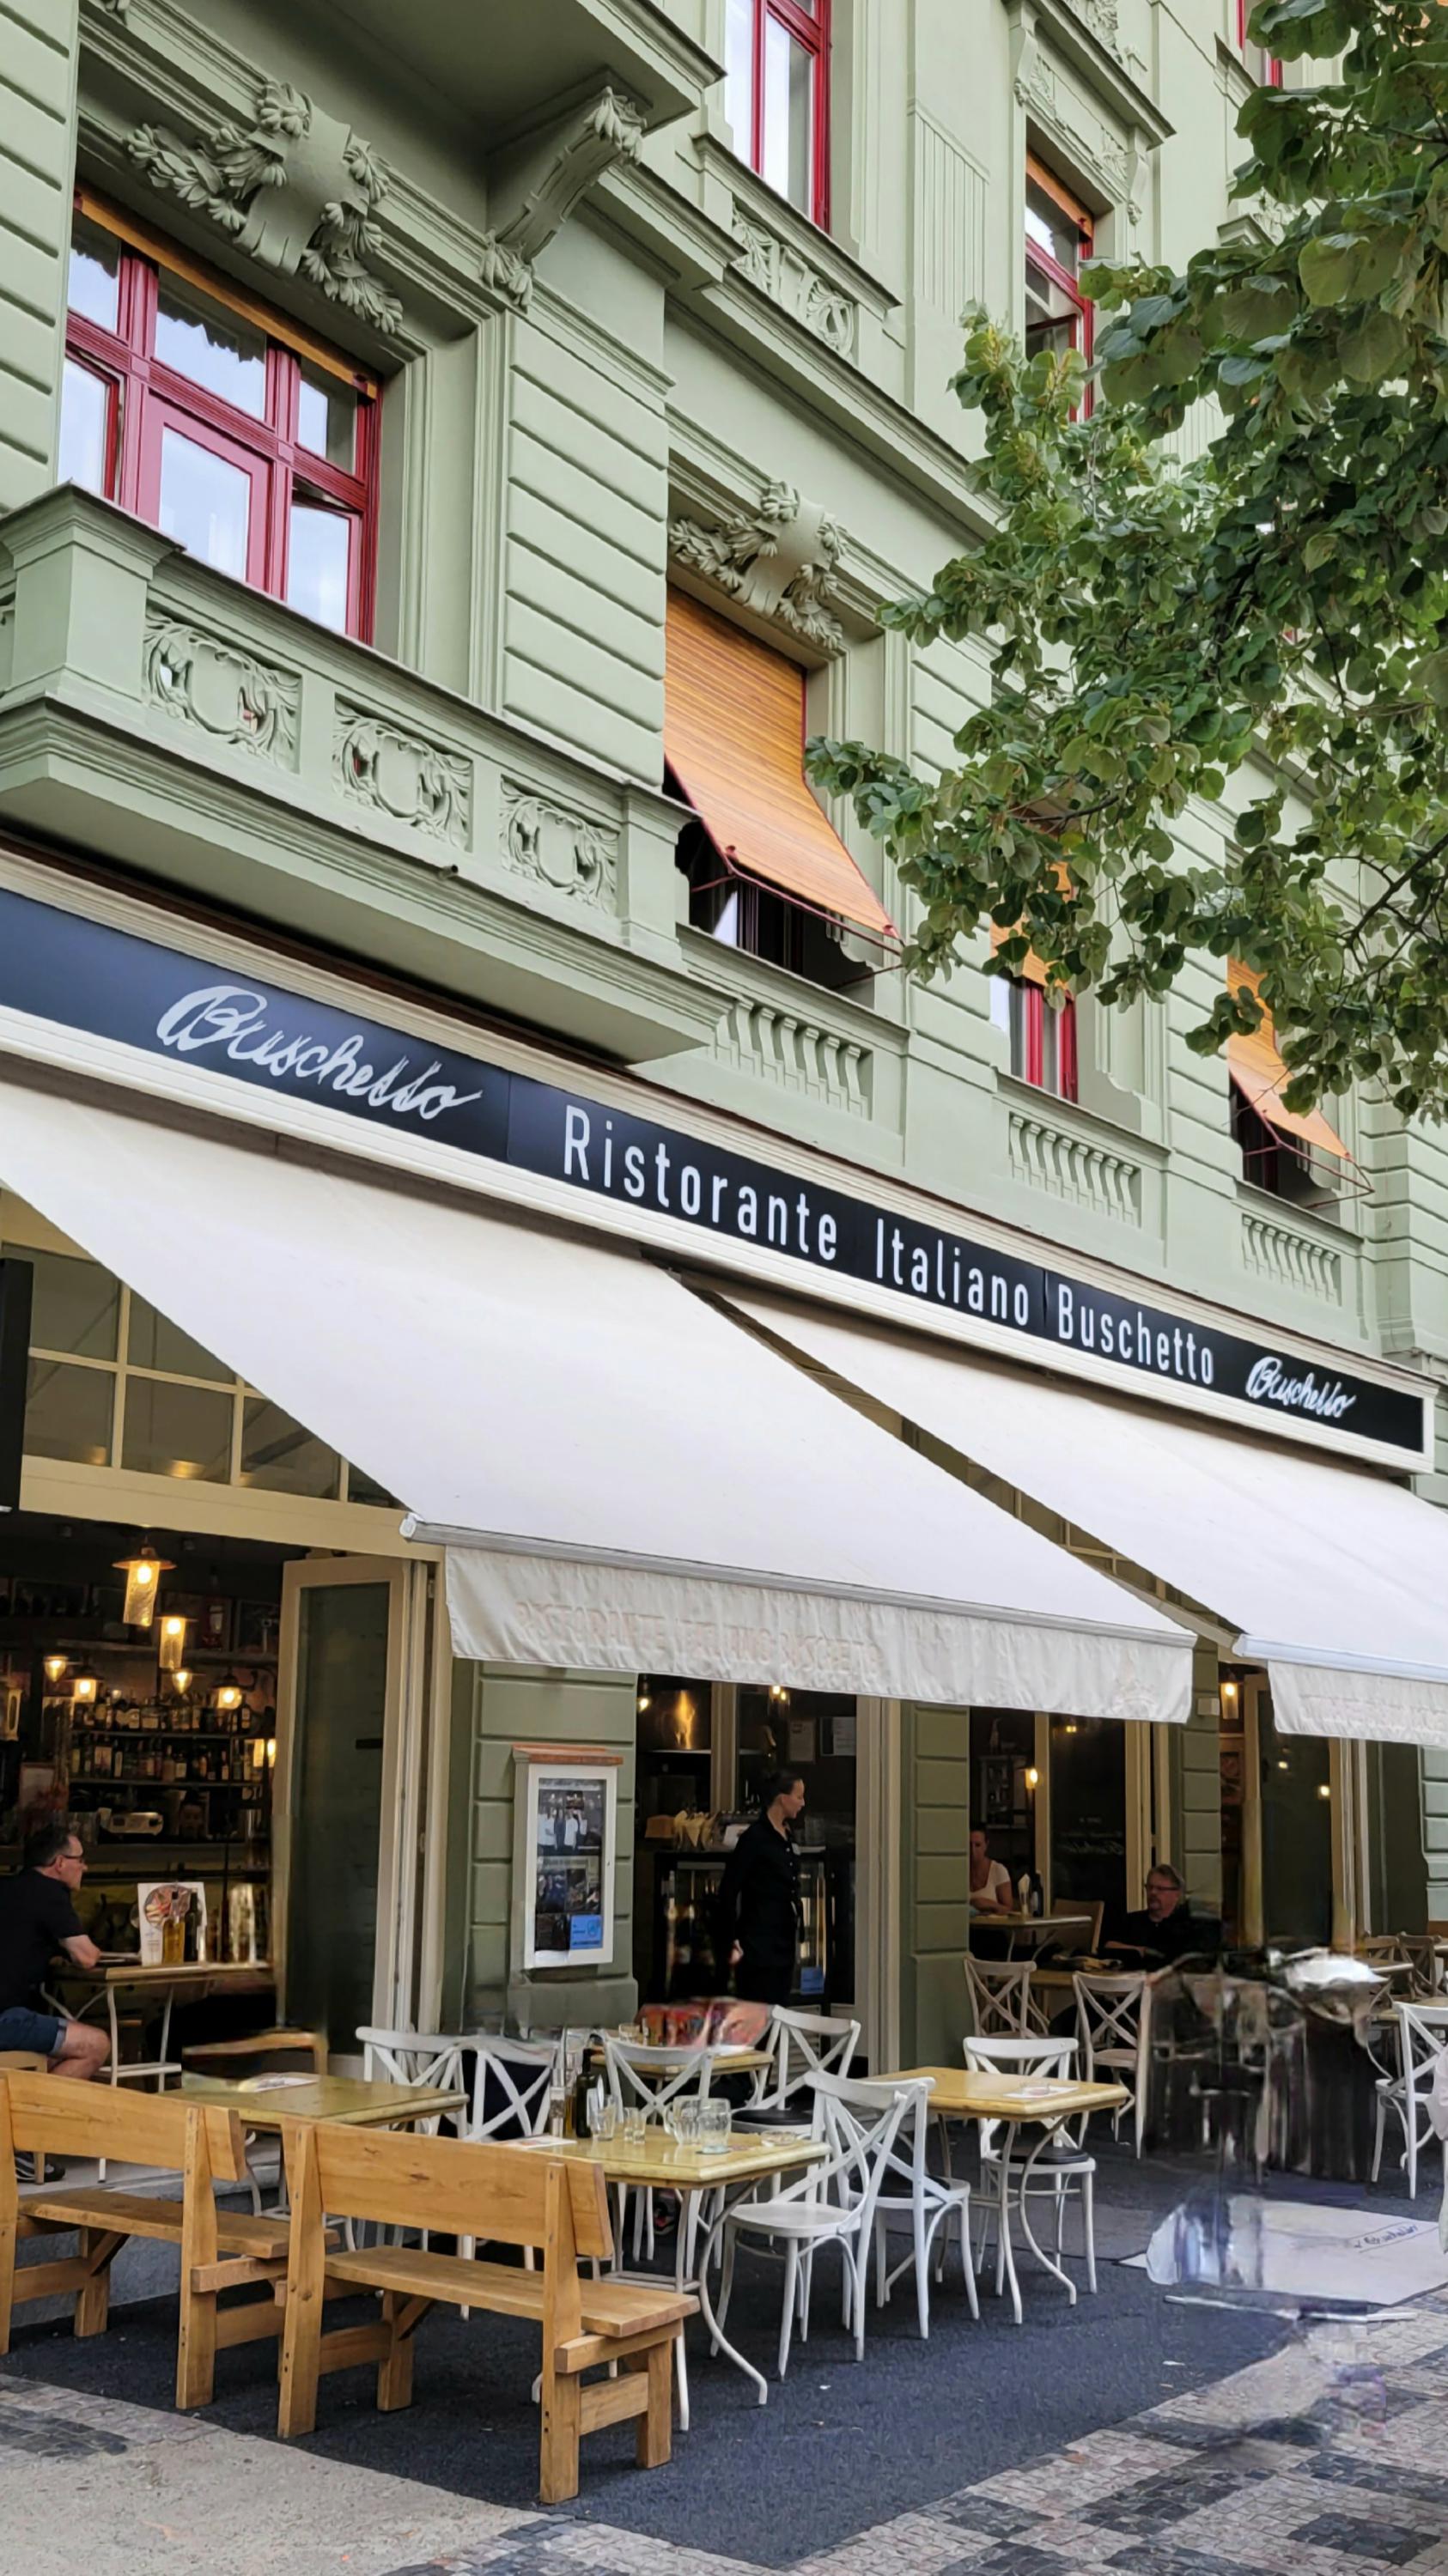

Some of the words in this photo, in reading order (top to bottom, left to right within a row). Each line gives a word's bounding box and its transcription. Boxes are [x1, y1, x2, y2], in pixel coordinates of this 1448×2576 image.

[563, 1103, 839, 1262] Ristorante
[875, 1217, 1031, 1327] Italiano
[1056, 1283, 1215, 1385] Buschetto
